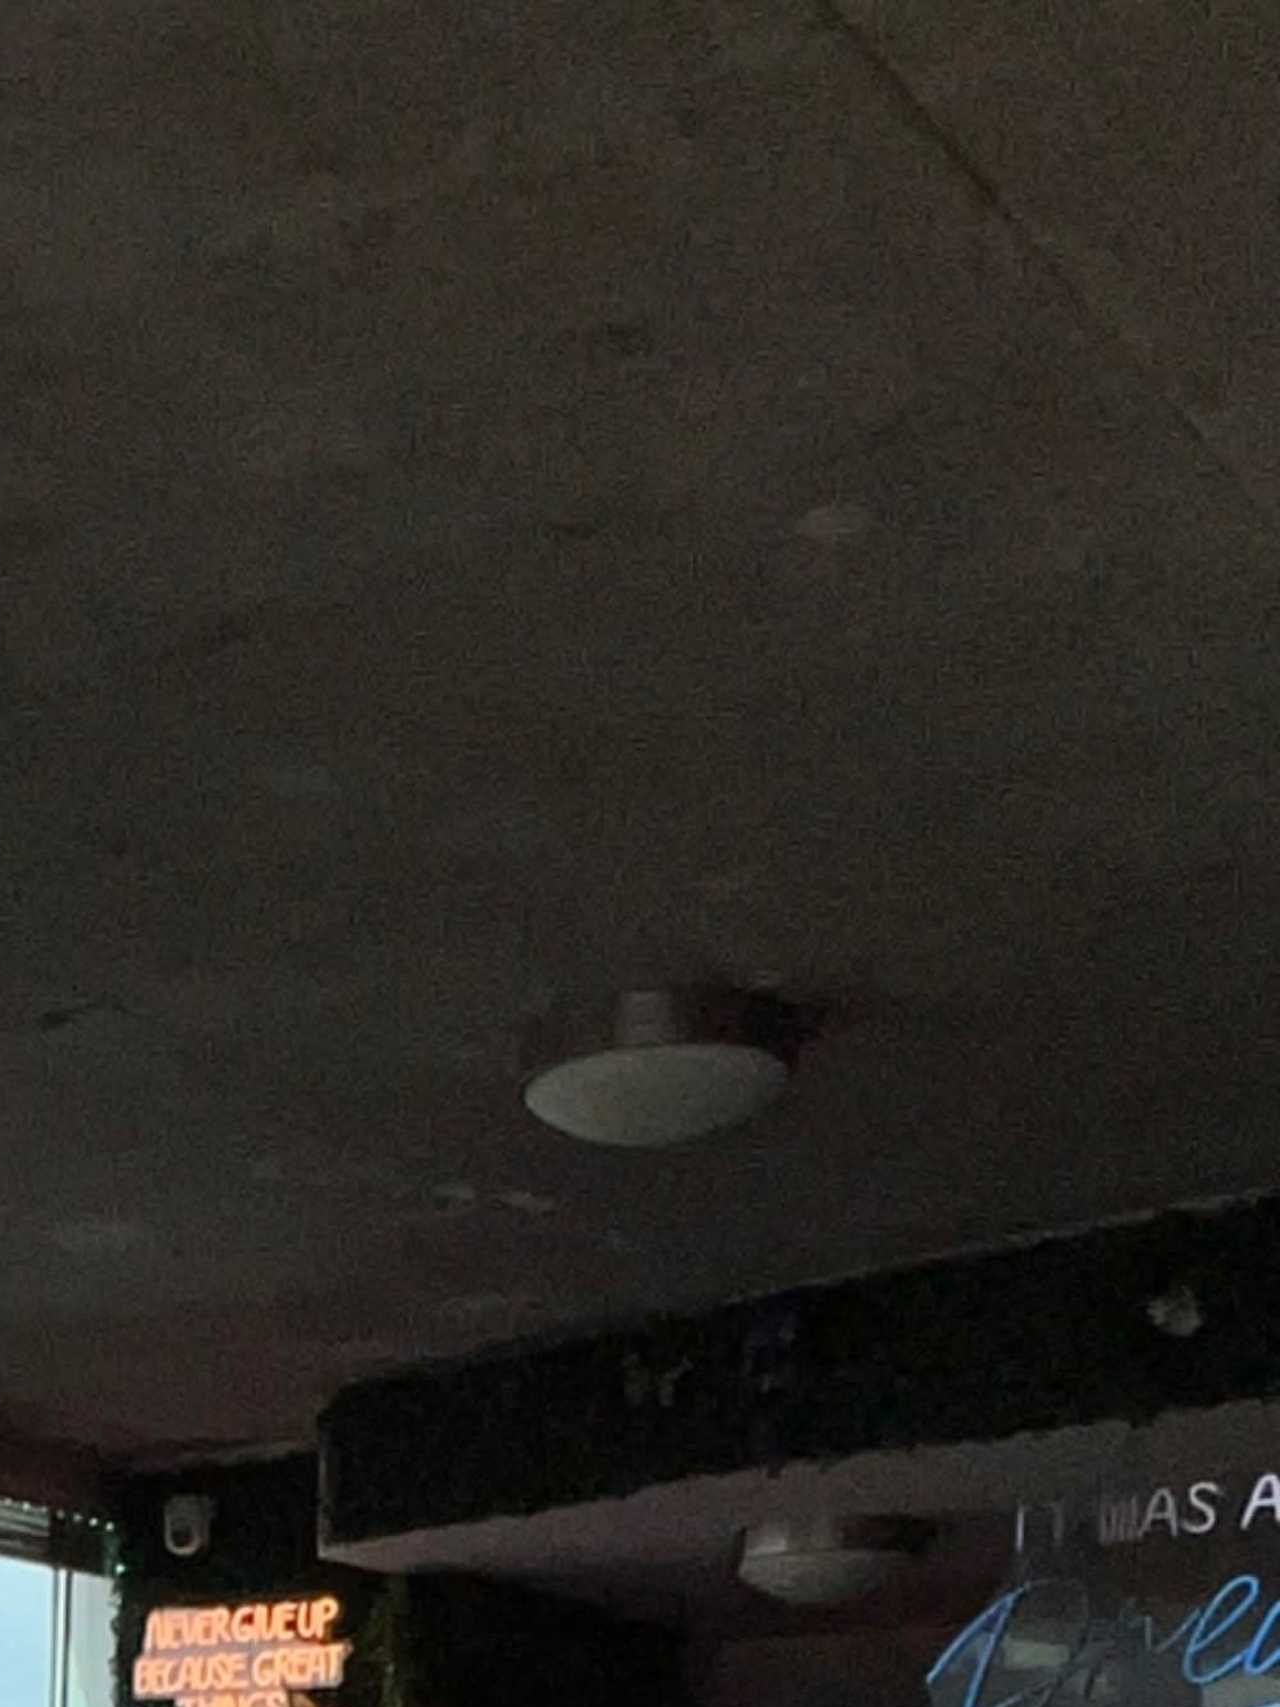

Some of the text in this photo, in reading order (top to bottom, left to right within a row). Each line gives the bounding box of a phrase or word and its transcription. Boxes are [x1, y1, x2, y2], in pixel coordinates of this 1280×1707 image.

[145, 1597, 338, 1650] NEVER GIVE UP
[134, 1645, 346, 1697] BECAUSE GREAT
